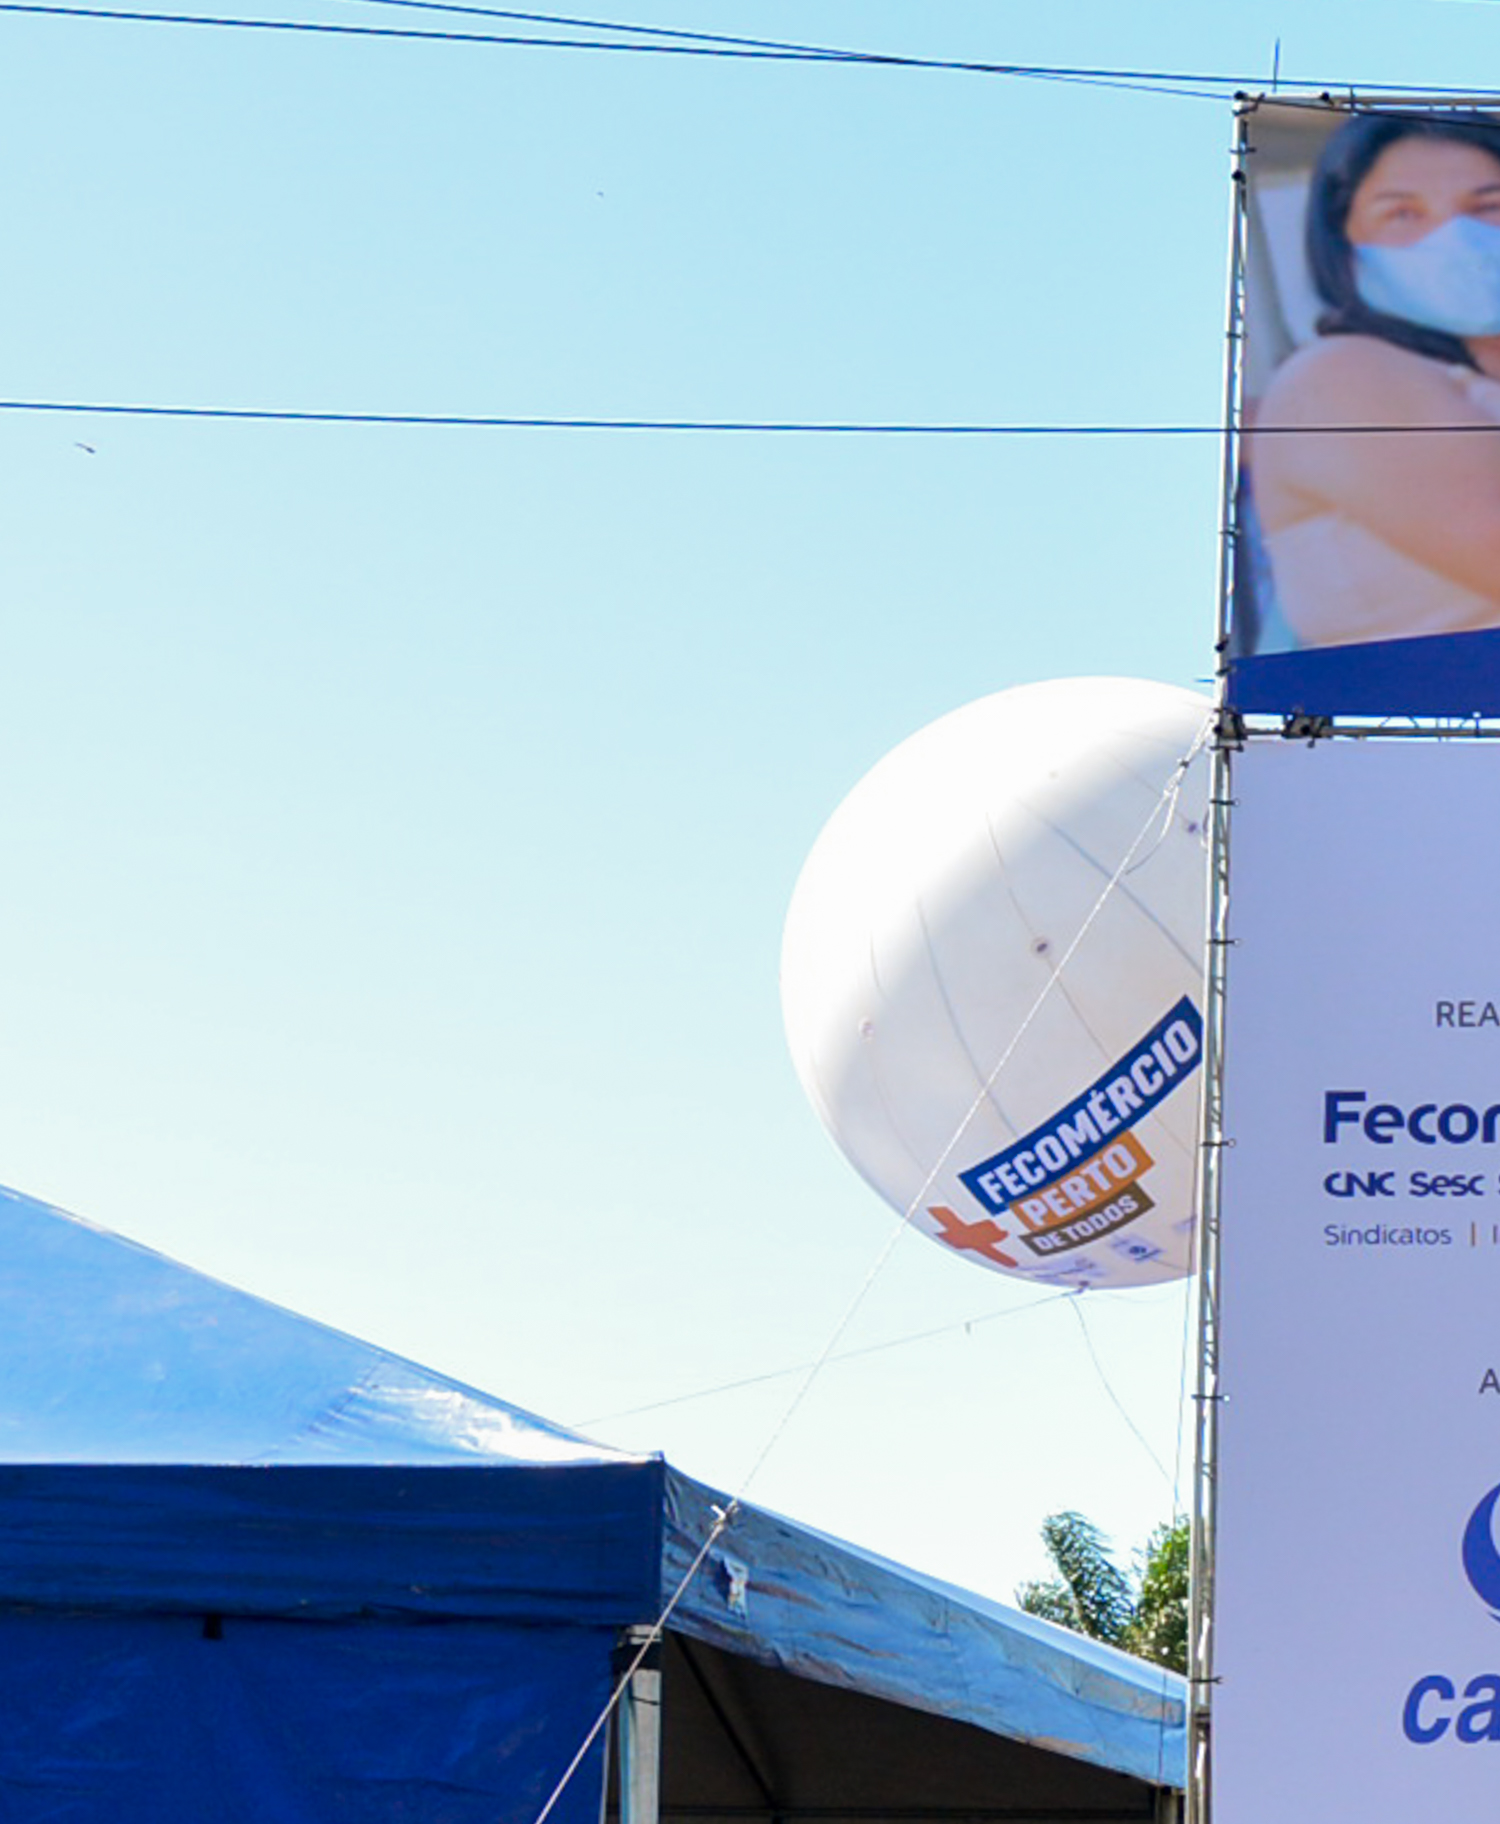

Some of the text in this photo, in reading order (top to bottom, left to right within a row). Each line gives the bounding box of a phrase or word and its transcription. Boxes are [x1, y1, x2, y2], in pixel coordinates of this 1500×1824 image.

[977, 1017, 1199, 1206] FECOMÉRCIO
[1020, 1142, 1139, 1231] PERTO
[1323, 1171, 1396, 1198] CNC
[1409, 1171, 1485, 1198] Sesc
[1033, 1234, 1066, 1252] DE
[1067, 1195, 1139, 1242] TODOS
[1322, 1223, 1453, 1247] Sindicatos
